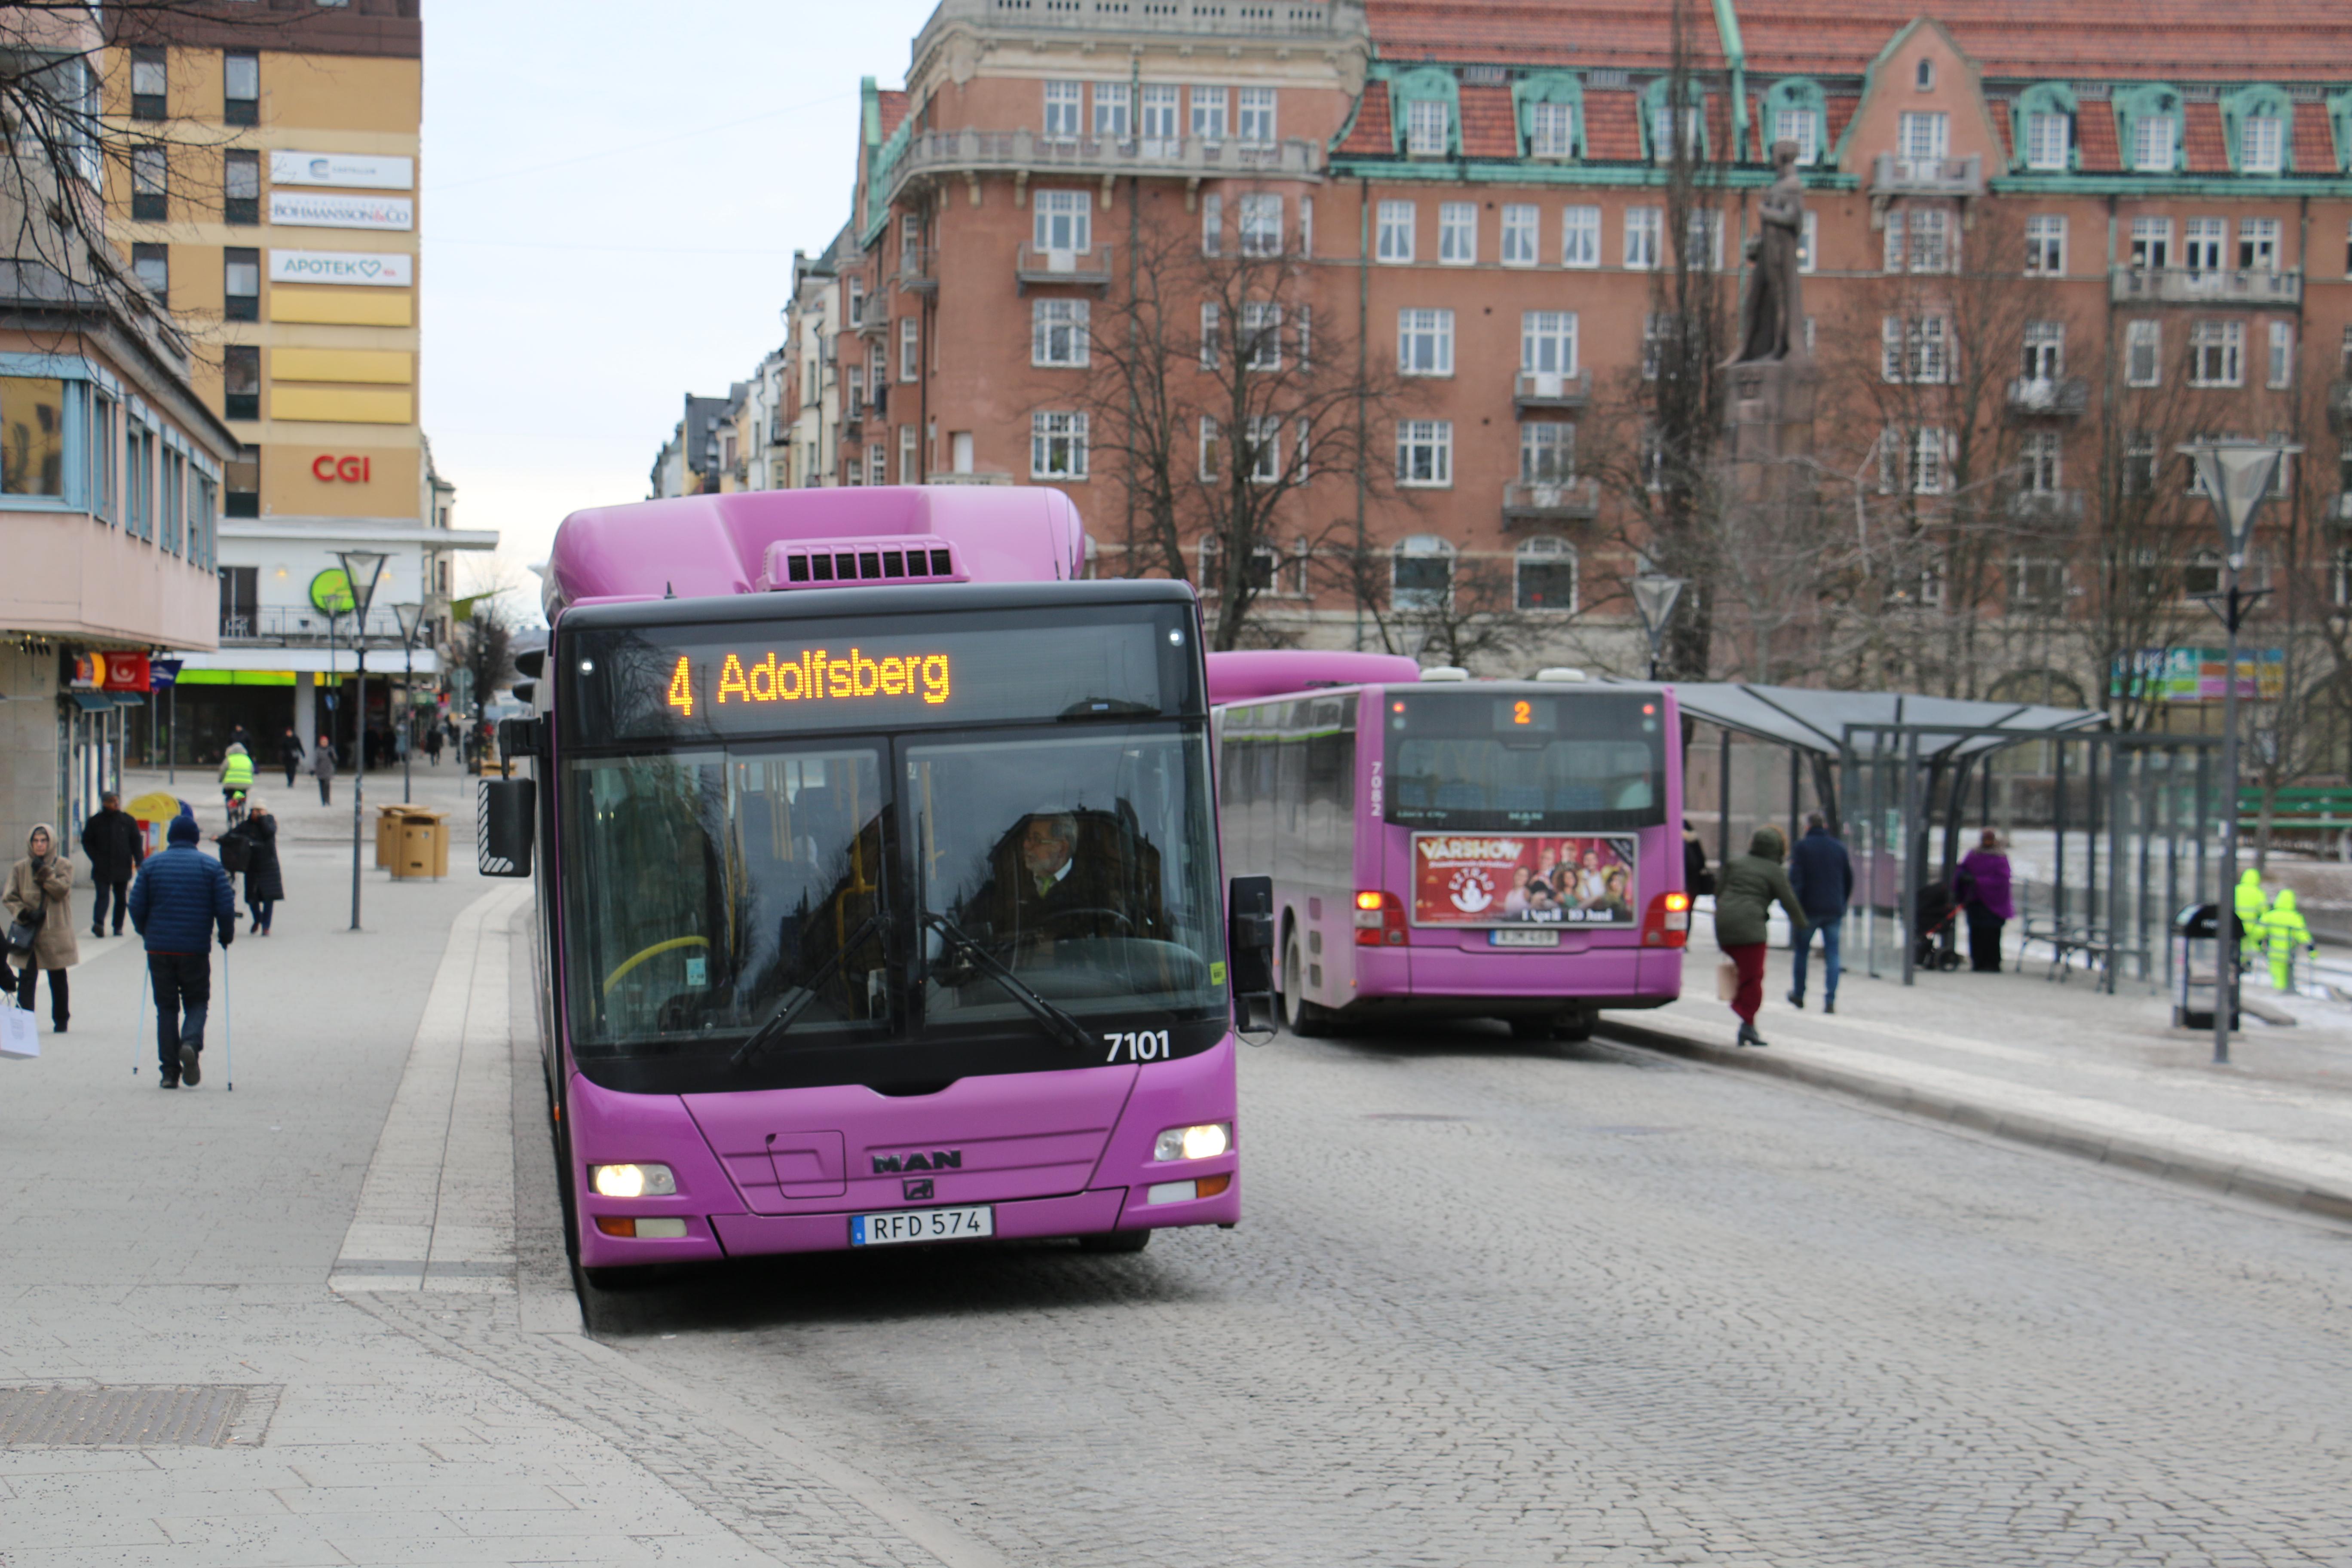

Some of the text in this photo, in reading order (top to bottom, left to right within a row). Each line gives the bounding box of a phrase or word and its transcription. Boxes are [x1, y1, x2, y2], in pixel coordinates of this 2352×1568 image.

[284, 258, 357, 275] APOTEK
[312, 455, 370, 483] CGI
[669, 648, 949, 716] 4 Adolfsberg
[1514, 700, 1531, 724] 2
[1371, 761, 1383, 817] 7082
[1419, 838, 1524, 860] VÅRSHOW
[1530, 908, 1562, 924] April
[1103, 1030, 1170, 1062] 7101
[873, 1150, 962, 1174] MAN
[875, 1216, 922, 1239] RFD
[931, 1211, 980, 1234] 574
